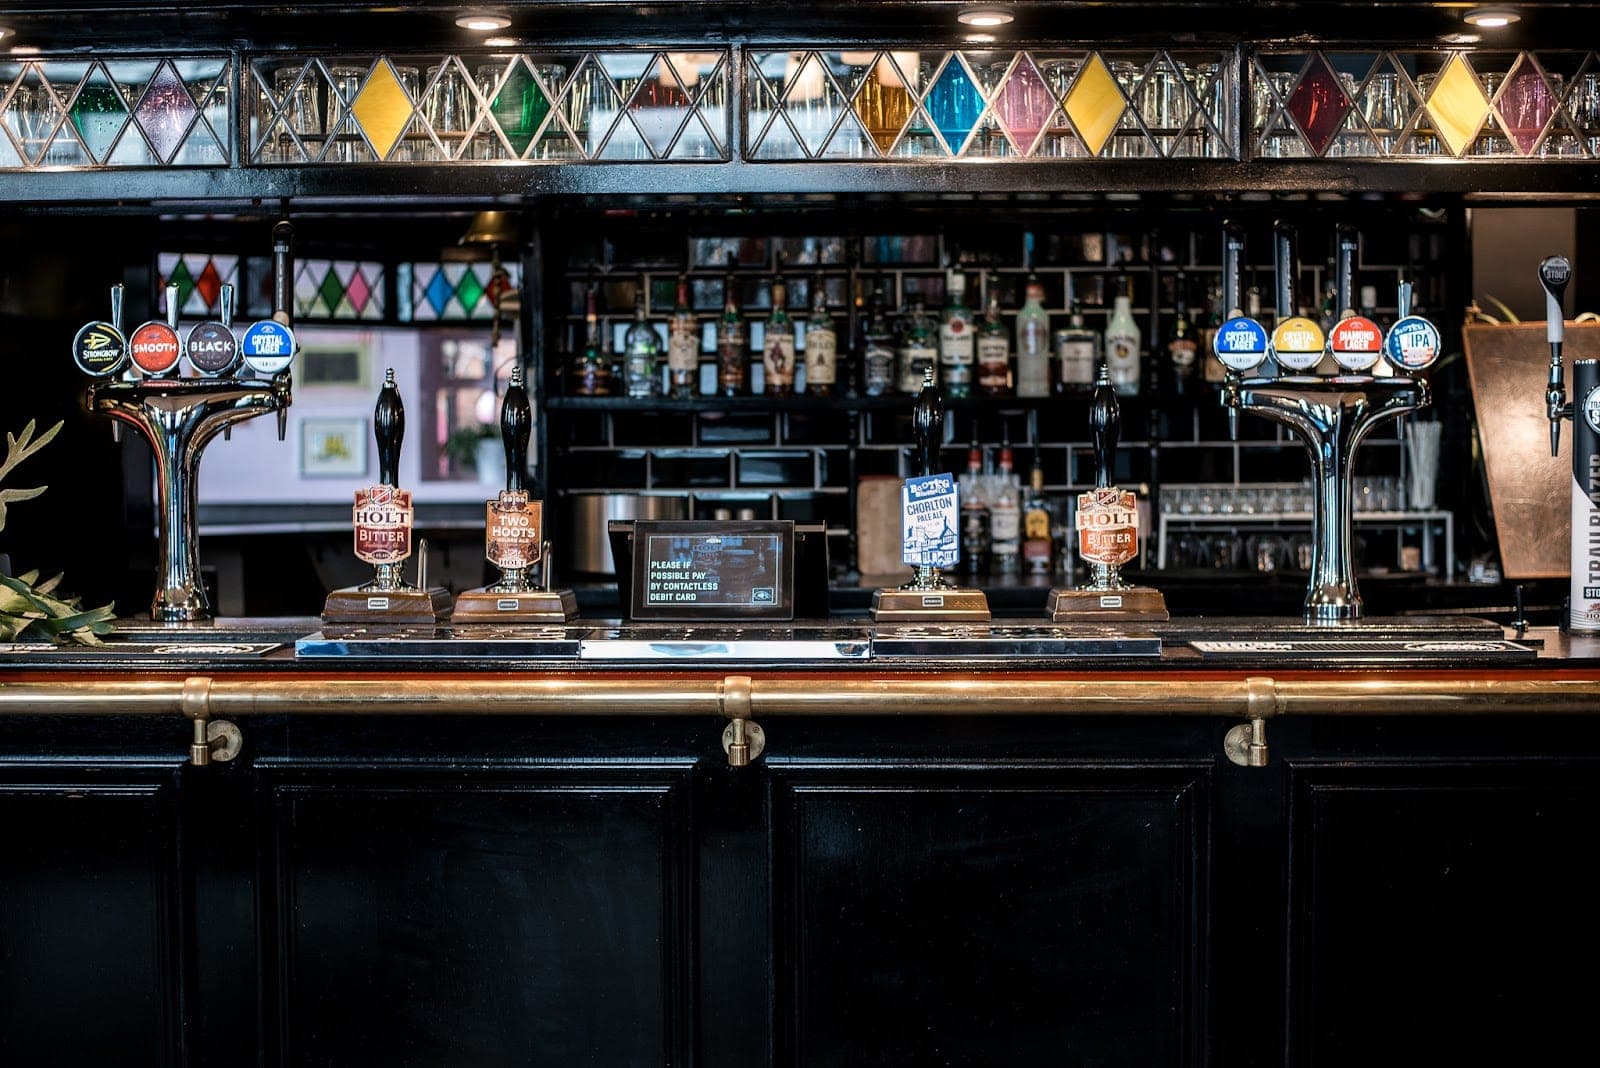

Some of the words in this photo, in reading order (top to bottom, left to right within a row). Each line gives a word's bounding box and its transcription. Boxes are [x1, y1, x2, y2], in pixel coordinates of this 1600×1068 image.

[252, 335, 284, 345] CRYSTAL
[1225, 331, 1258, 341] CRYSTAL
[1339, 330, 1375, 341] DIAMOND
[1411, 333, 1430, 348] IPA
[134, 343, 177, 353] SMOOTH
[191, 341, 232, 352] BLACK
[255, 344, 280, 354] LAGER
[1229, 340, 1255, 350] LAGER
[1344, 340, 1370, 350] LAGER
[907, 497, 953, 516] CHORLTON
[356, 511, 409, 523] HOLT
[498, 514, 529, 526] TWO
[917, 513, 932, 522] PALE
[933, 511, 944, 519] ALE
[1080, 512, 1137, 526] HOLT
[359, 529, 405, 542] BITTER
[492, 525, 536, 538] HOOTS
[1088, 533, 1131, 545] BITTER
[651, 561, 681, 569] PLEASE
[683, 561, 692, 569] IF
[650, 571, 690, 580] POSSIBLE
[692, 571, 706, 580] PAY
[650, 582, 661, 590] BY
[663, 582, 718, 590] CONTACTLESS
[650, 592, 673, 601] DEBIT
[675, 592, 697, 601] CARD
